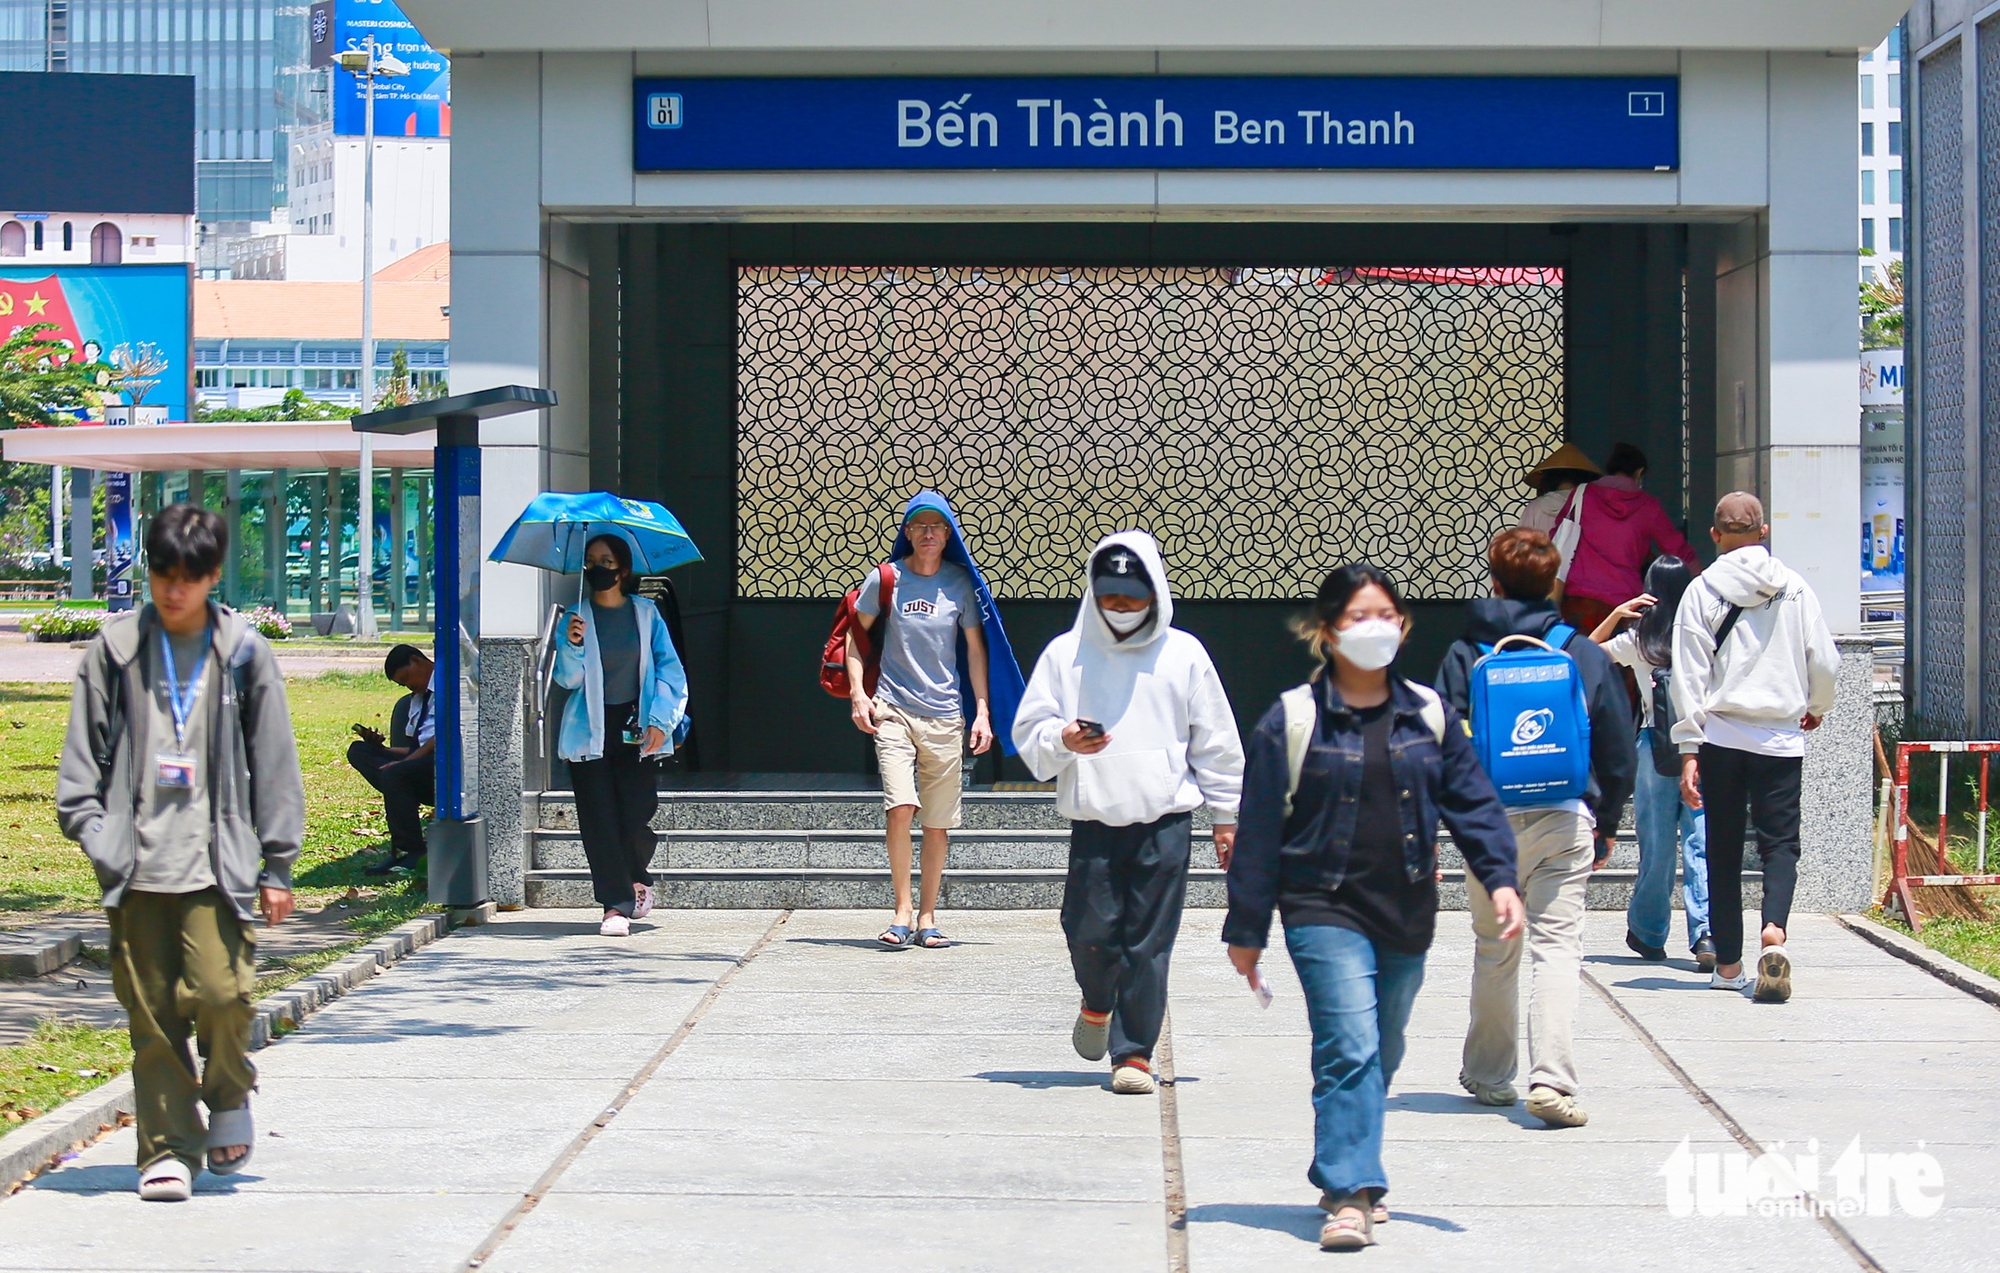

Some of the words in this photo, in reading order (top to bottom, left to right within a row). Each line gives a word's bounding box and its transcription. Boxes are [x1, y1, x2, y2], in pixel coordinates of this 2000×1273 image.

[378, 20, 406, 28] COSMO
[659, 97, 671, 109] L1
[1643, 96, 1650, 112] 1
[657, 109, 673, 125] 01
[897, 93, 998, 148] Bến
[1016, 98, 1184, 147] Thành
[1214, 110, 1285, 145] Ben
[1297, 110, 1415, 145] Thanh
[903, 600, 937, 615] JUST
